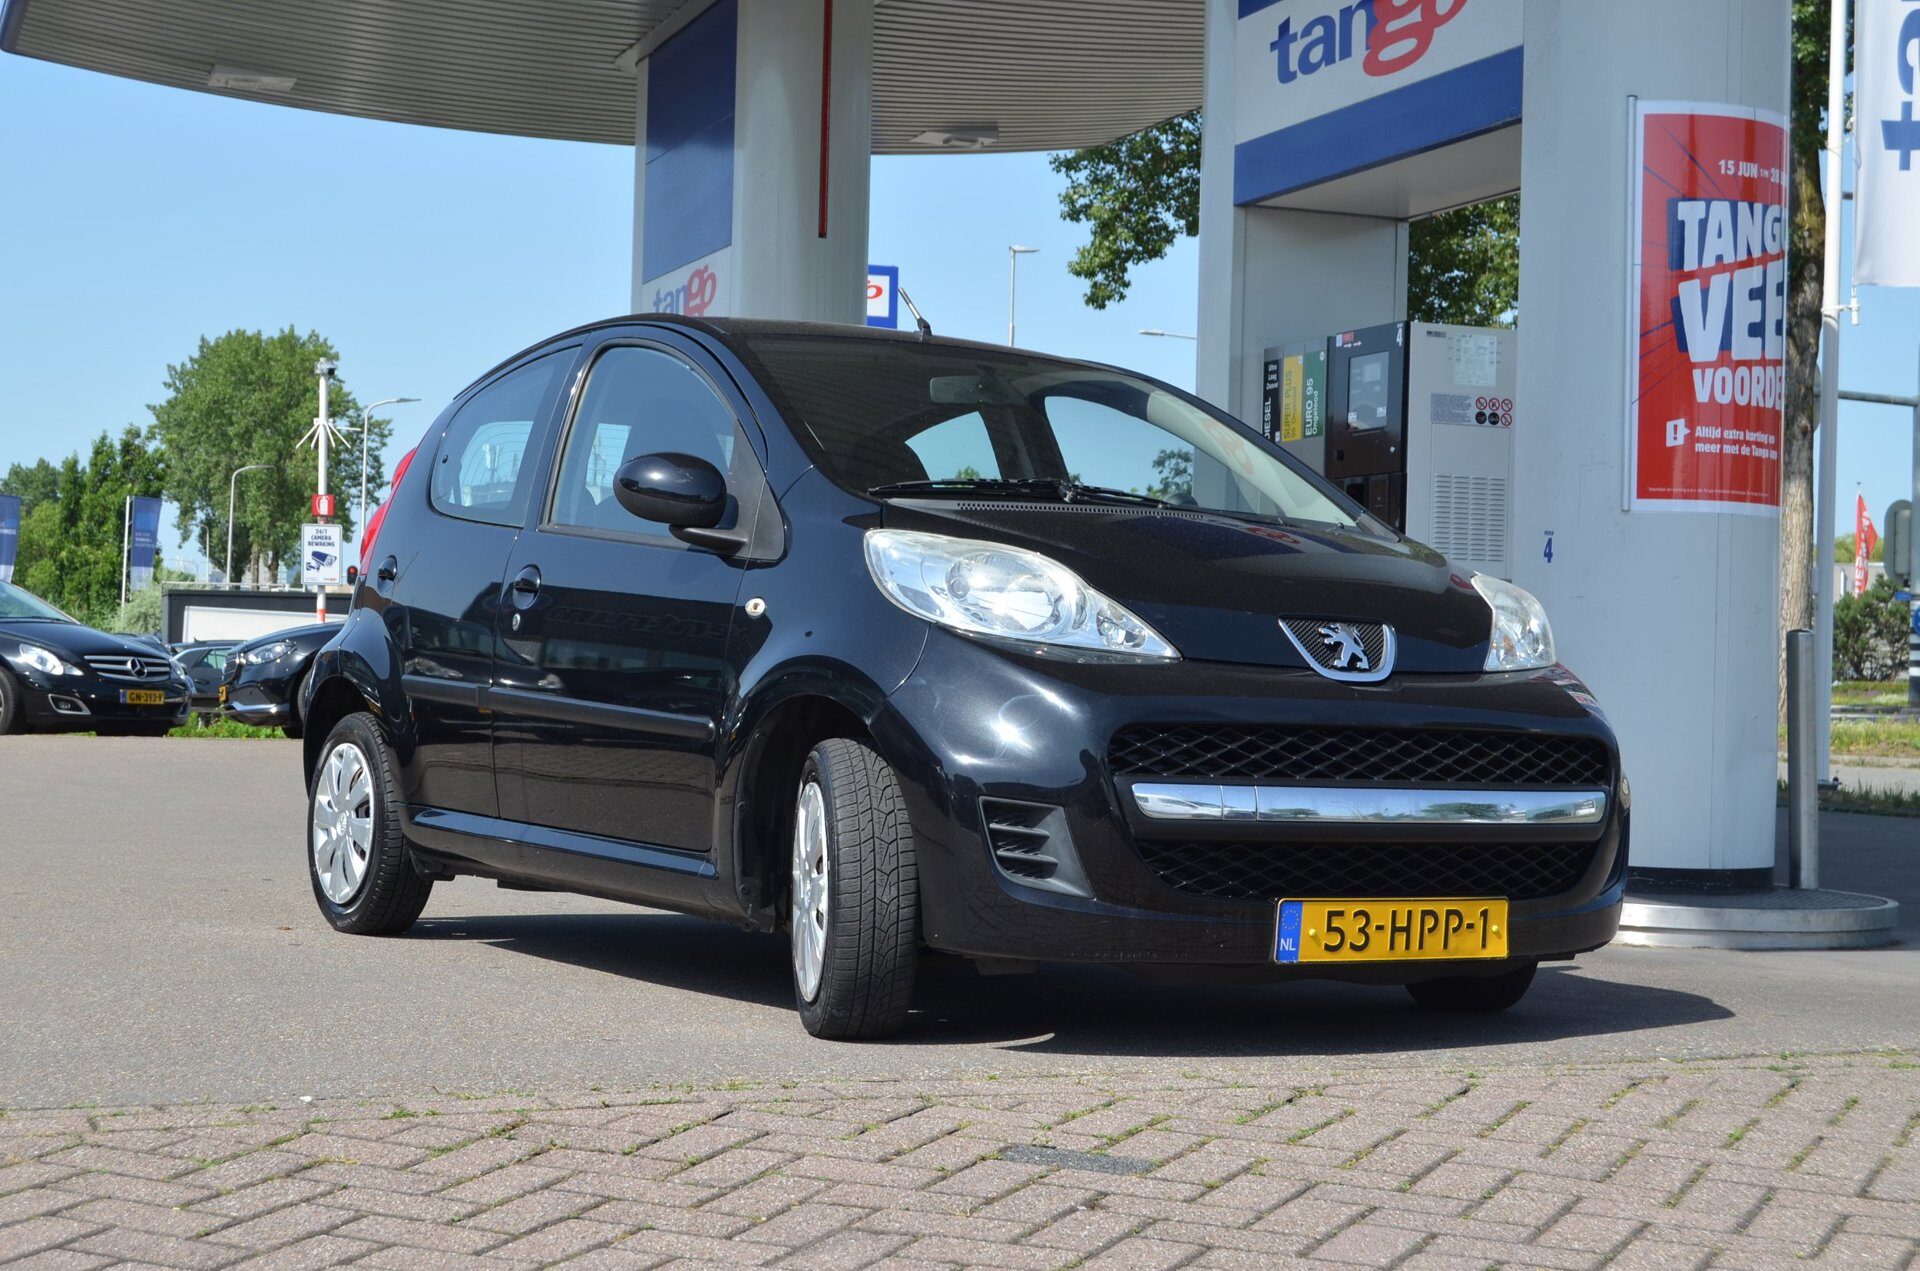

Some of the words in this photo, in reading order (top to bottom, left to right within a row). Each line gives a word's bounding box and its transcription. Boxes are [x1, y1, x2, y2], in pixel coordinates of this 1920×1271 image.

[1719, 160, 1735, 175] 15
[1738, 161, 1758, 178] JUN
[1771, 167, 1780, 183] 28
[1306, 378, 1314, 395] 95
[1305, 400, 1313, 436] EURO
[1695, 425, 1721, 439] Altijd
[1723, 429, 1744, 440] extra
[1695, 443, 1720, 453] meer
[1723, 444, 1739, 455] met
[1741, 445, 1750, 456] de
[1752, 445, 1769, 459] Tango
[1543, 537, 1553, 563] 4
[1322, 906, 1490, 952] 53-HPP-1
[1280, 937, 1296, 951] NL
